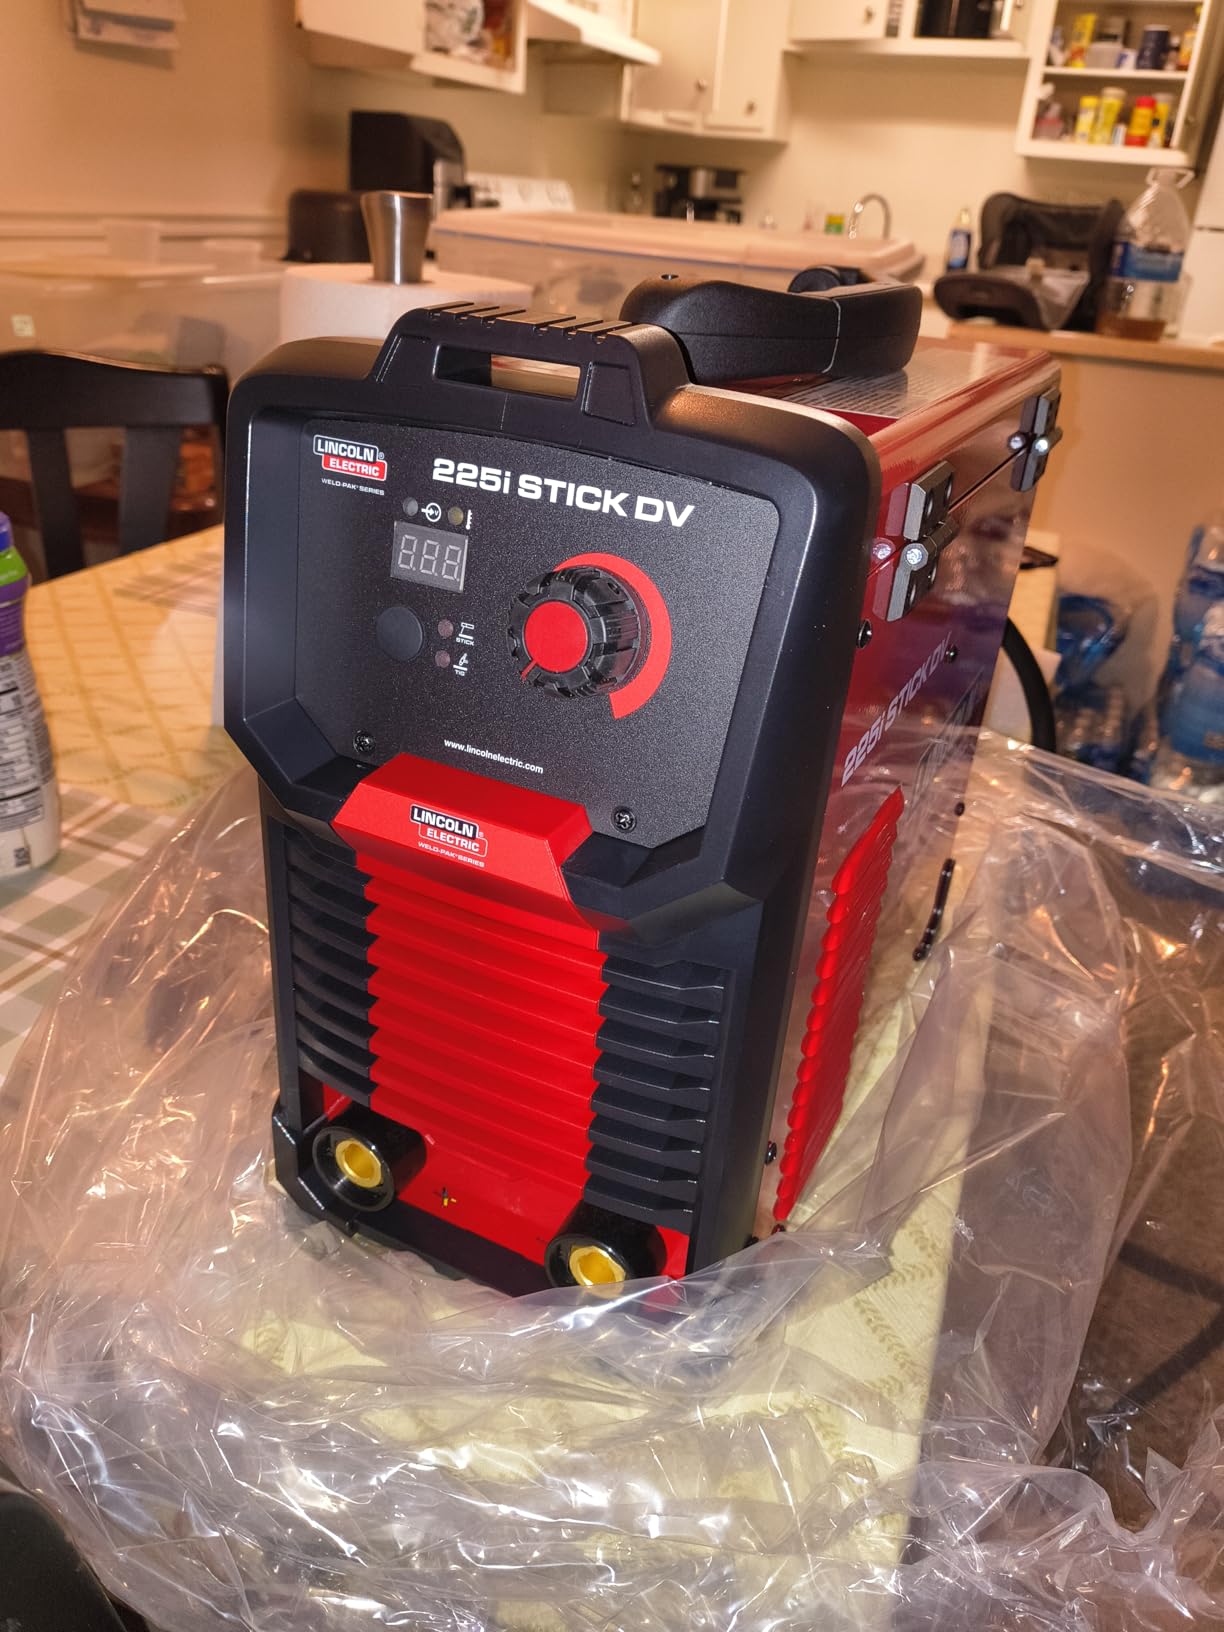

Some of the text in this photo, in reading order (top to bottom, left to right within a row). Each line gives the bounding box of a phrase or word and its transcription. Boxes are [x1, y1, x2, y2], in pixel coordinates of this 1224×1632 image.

[317, 439, 375, 462] LINCOLN
[329, 458, 380, 477] ELECTRIC
[359, 485, 385, 496] SERIES
[432, 458, 695, 528] 225i STICK DV
[455, 637, 475, 646] STICK
[454, 669, 466, 677] TIG
[841, 711, 886, 788] 225i
[884, 655, 931, 732] STICK
[443, 739, 544, 775] www.lincolnelectric.com
[413, 807, 474, 838] LINCOLN
[426, 827, 480, 852] ELECTRIC
[457, 854, 485, 868] SERIES
